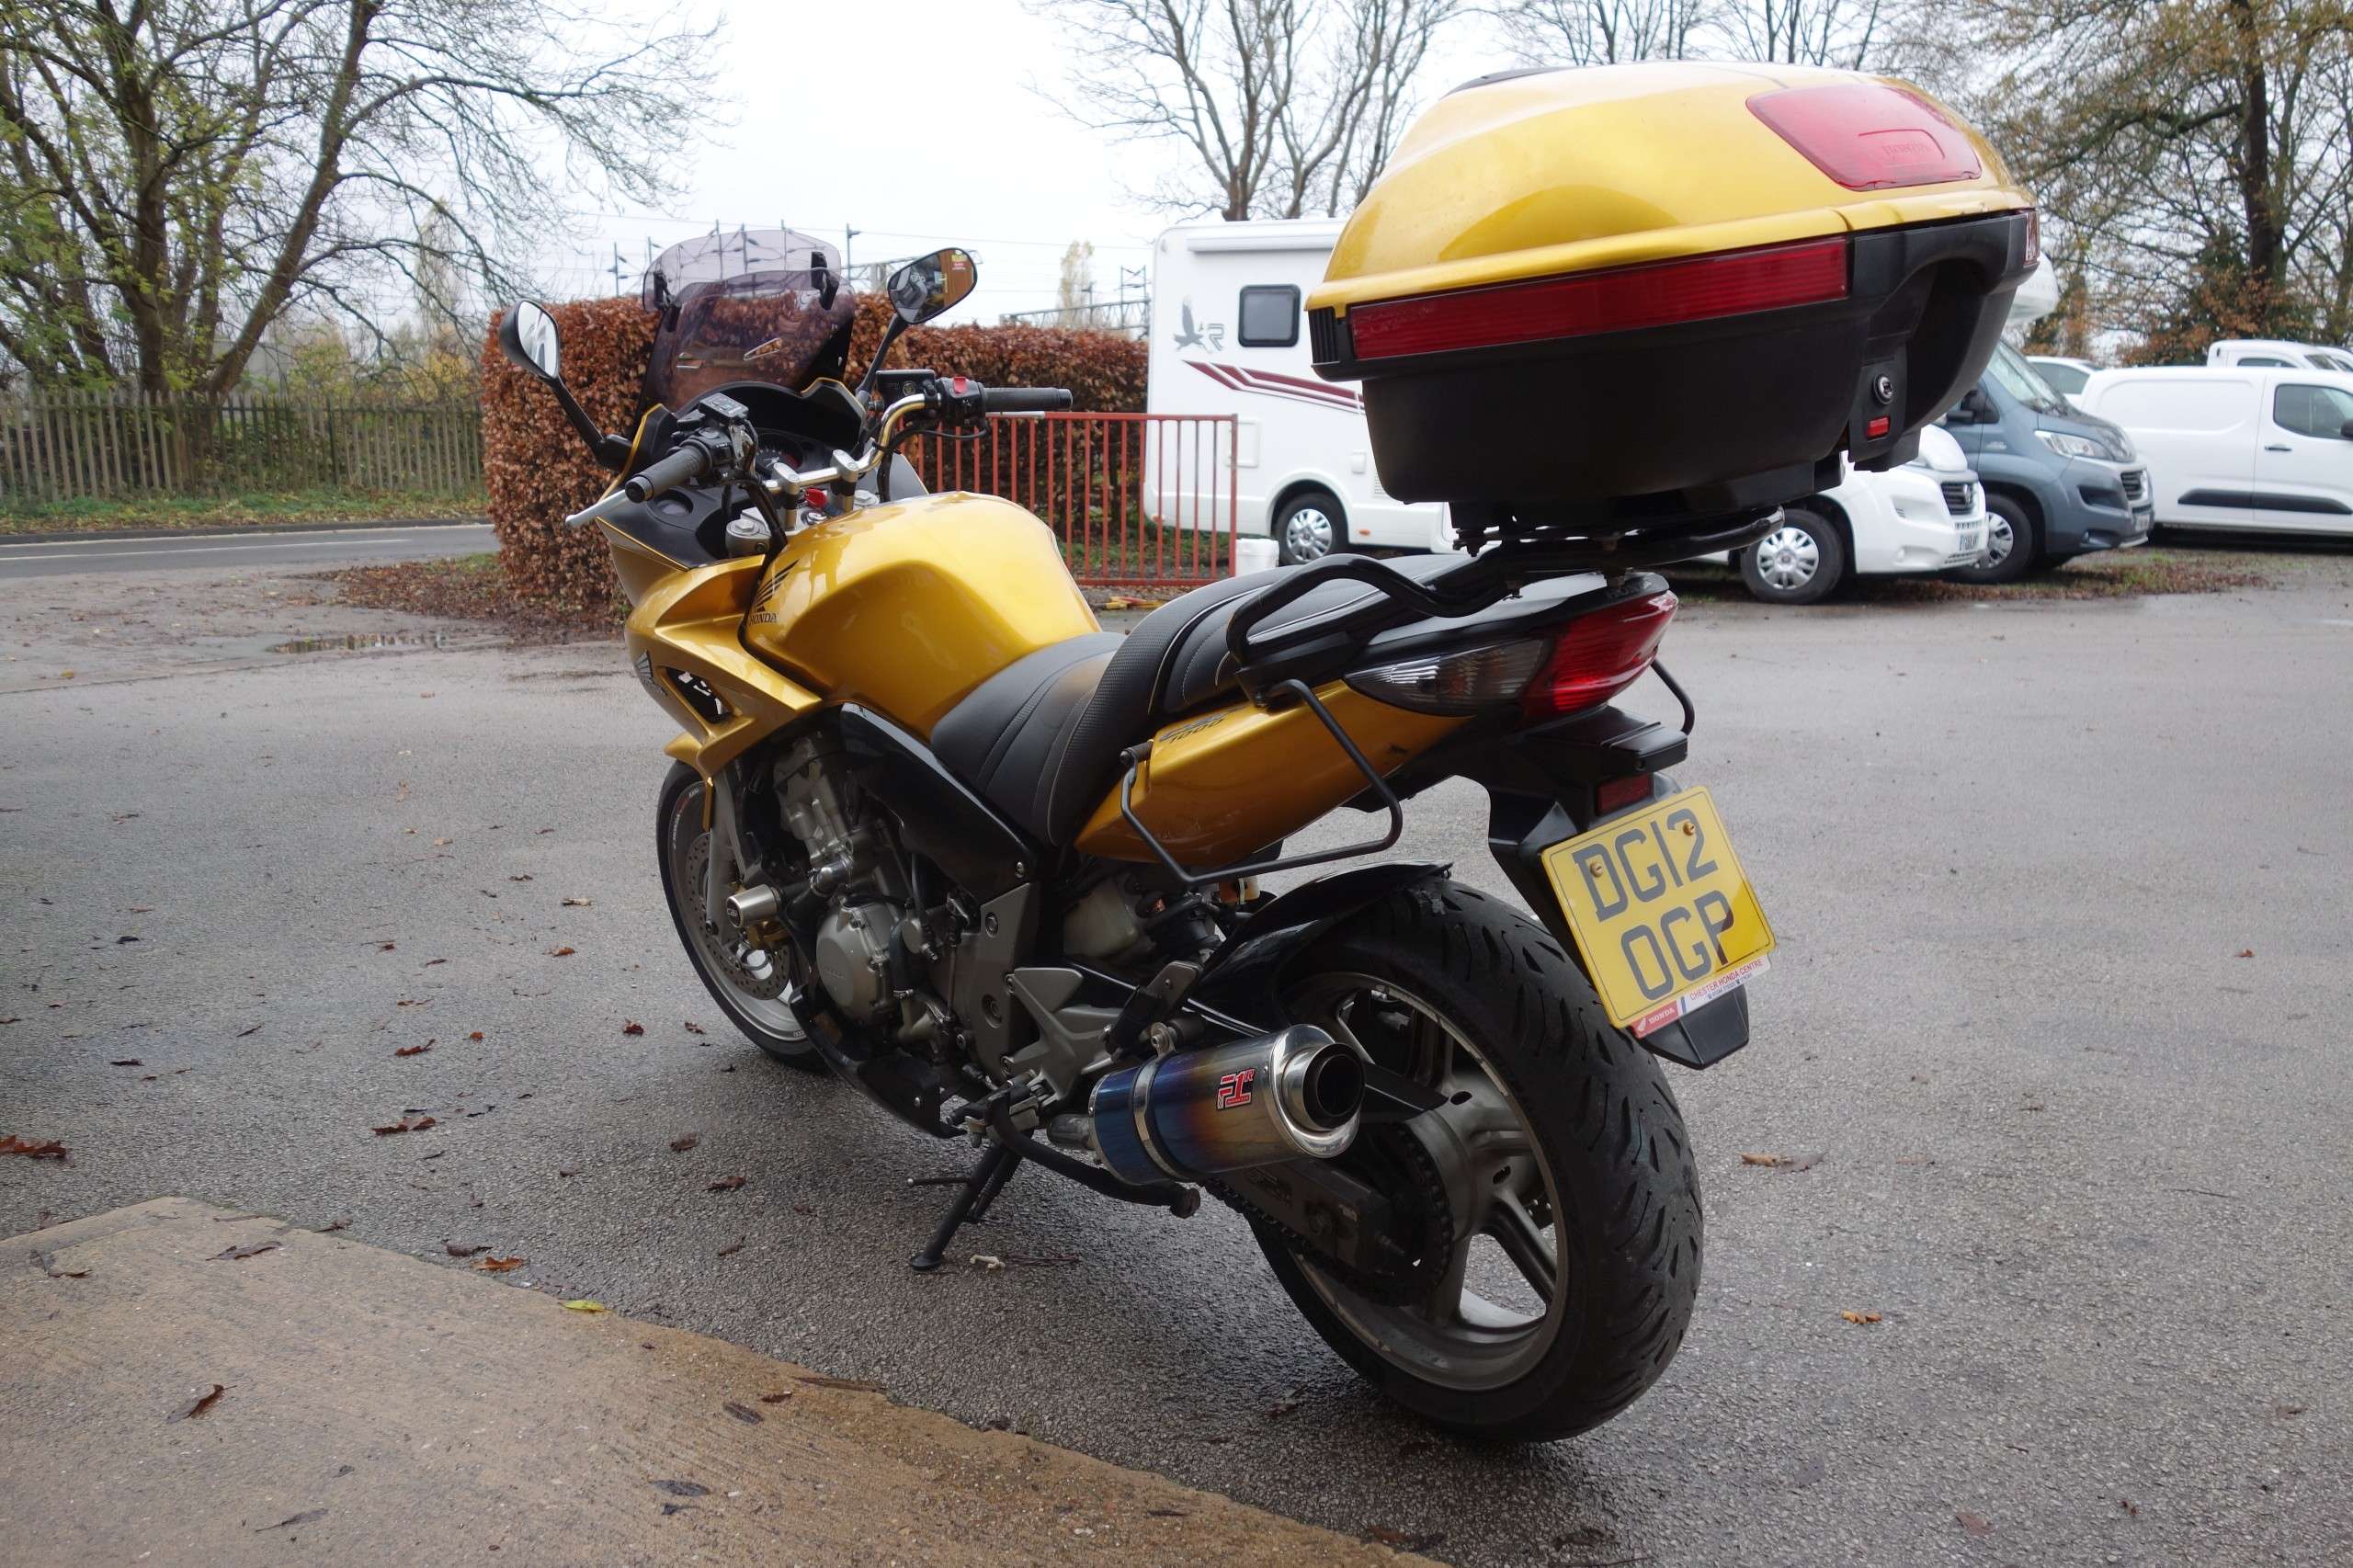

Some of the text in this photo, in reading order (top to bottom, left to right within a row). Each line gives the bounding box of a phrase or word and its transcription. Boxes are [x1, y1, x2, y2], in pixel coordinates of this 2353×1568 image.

[1572, 808, 1719, 922] DG12
[1620, 890, 1735, 1001] OGP
[1689, 981, 1719, 1001] CHESTER
[1717, 971, 1741, 986] HONDA
[1739, 958, 1766, 974] CENTRE
[1648, 1006, 1676, 1025] HONDA
